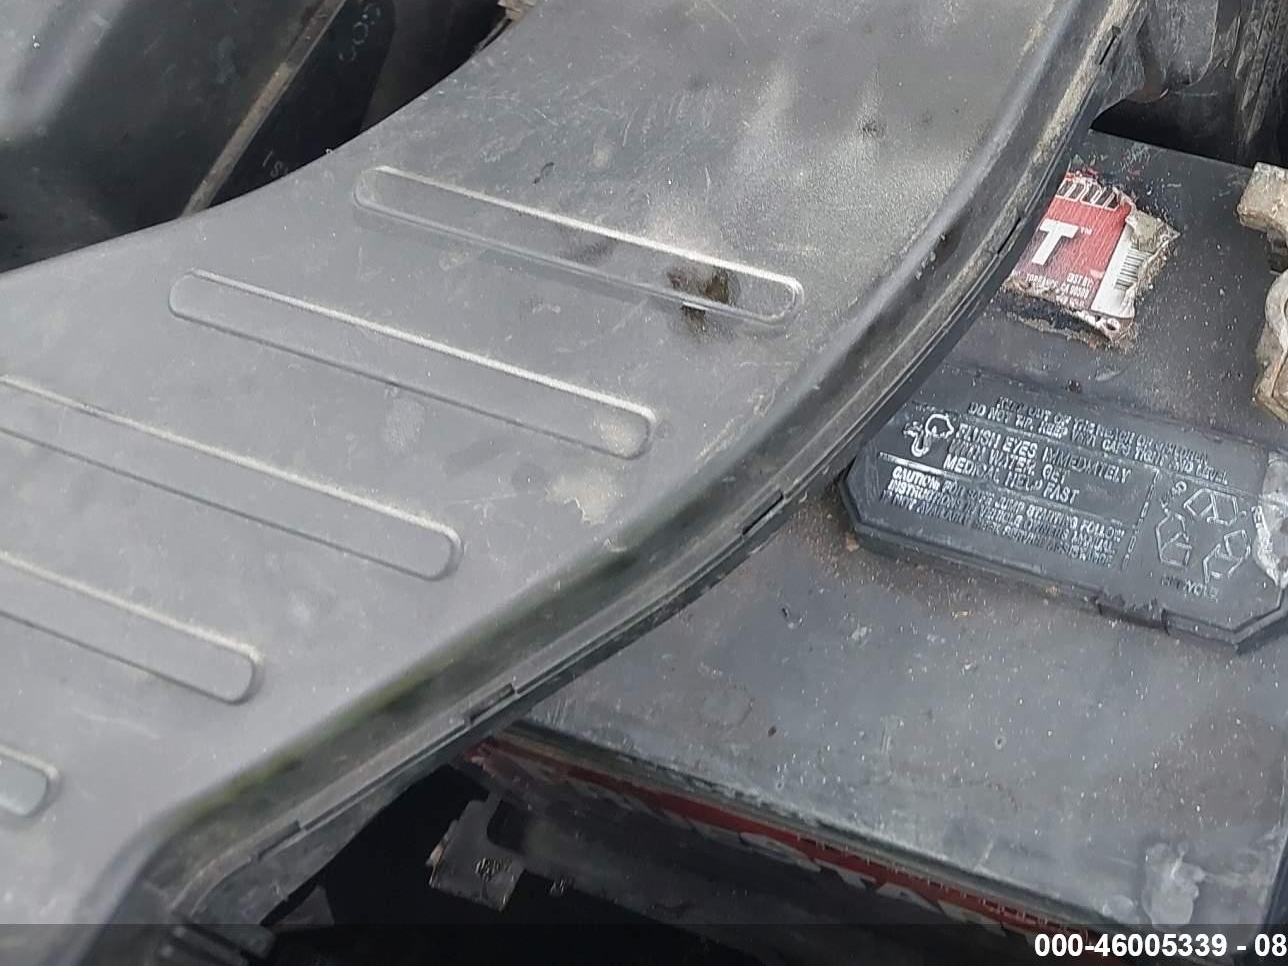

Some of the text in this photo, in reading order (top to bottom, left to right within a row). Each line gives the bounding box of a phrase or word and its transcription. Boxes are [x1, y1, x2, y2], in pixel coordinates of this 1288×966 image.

[1031, 218, 1079, 265] T
[955, 421, 1002, 449] FLUSH
[1002, 434, 1039, 459] EYES
[942, 452, 1002, 484] MEDICAL
[1042, 481, 1079, 505] FAST
